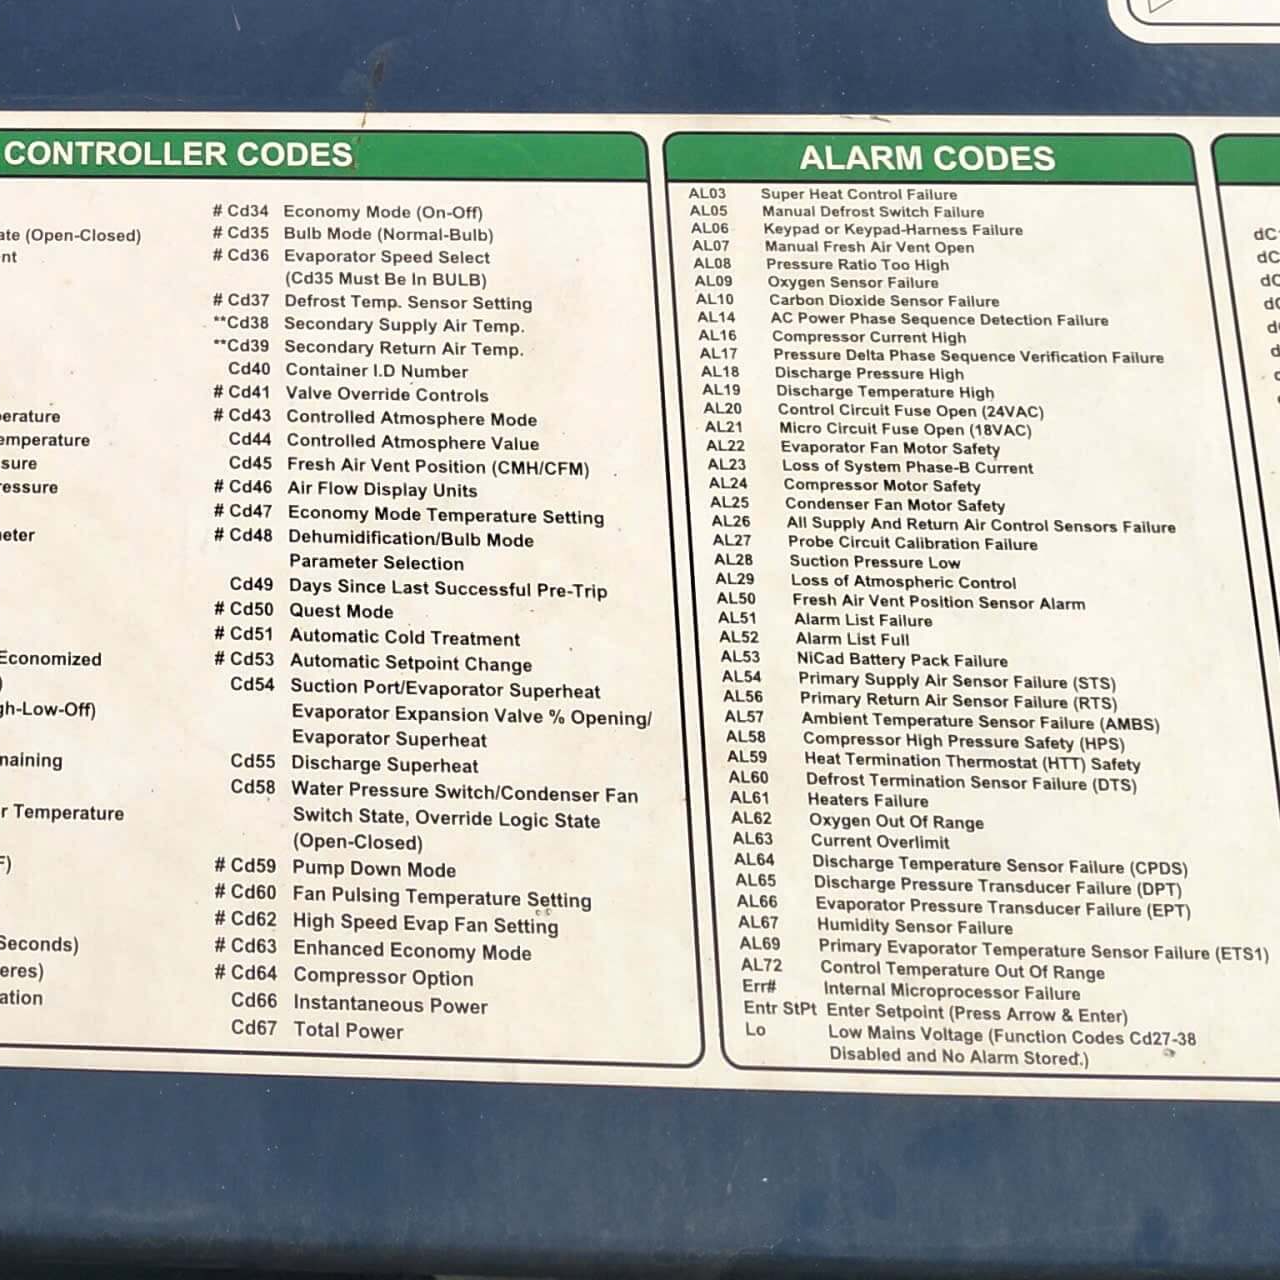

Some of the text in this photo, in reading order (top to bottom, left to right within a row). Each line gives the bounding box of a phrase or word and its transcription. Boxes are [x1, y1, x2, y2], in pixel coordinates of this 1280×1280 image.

[4, 140, 354, 168] CONTROLLER CODES
[799, 144, 1056, 173] ALARM CODES
[688, 187, 958, 203] AL03 Super Heat Control Failure
[25, 228, 142, 246] (Open-Closed)
[227, 225, 270, 240] Cd35
[283, 226, 322, 240] Bulb
[327, 226, 372, 241] Mode
[377, 226, 494, 245] (Normal-Bulb)
[704, 420, 1032, 440] AL21 Micro Circuit Fuse Open (18VAC)
[228, 455, 590, 481] Cd45 Fresh Air Vent Position (CMH/CFM)
[229, 575, 608, 603] Cd49 Days Since Last Successful Pre-Trip
[720, 649, 1009, 670] AL53 NiCad Battery Pack Failure
[291, 702, 391, 723] Evaporator
[395, 705, 489, 726] Expansion
[493, 707, 544, 724] Valve
[570, 709, 653, 730] Opening/
[733, 851, 1188, 880] AL64 Discharge Temperature Sensor Failure (CPDS)
[230, 910, 278, 928] Cd62
[293, 911, 335, 933] High
[340, 912, 398, 934] Speed
[403, 914, 449, 936] Evap
[454, 916, 488, 934] Fan
[493, 917, 559, 939] Setting
[743, 999, 779, 1015] Entr
[782, 1000, 818, 1017] StPt
[826, 1002, 871, 1018] Enter
[875, 1003, 945, 1023] Setpoint
[948, 1004, 1002, 1024] (Press
[1006, 1006, 1057, 1022] Arrow
[1078, 1007, 1128, 1027] Enter)
